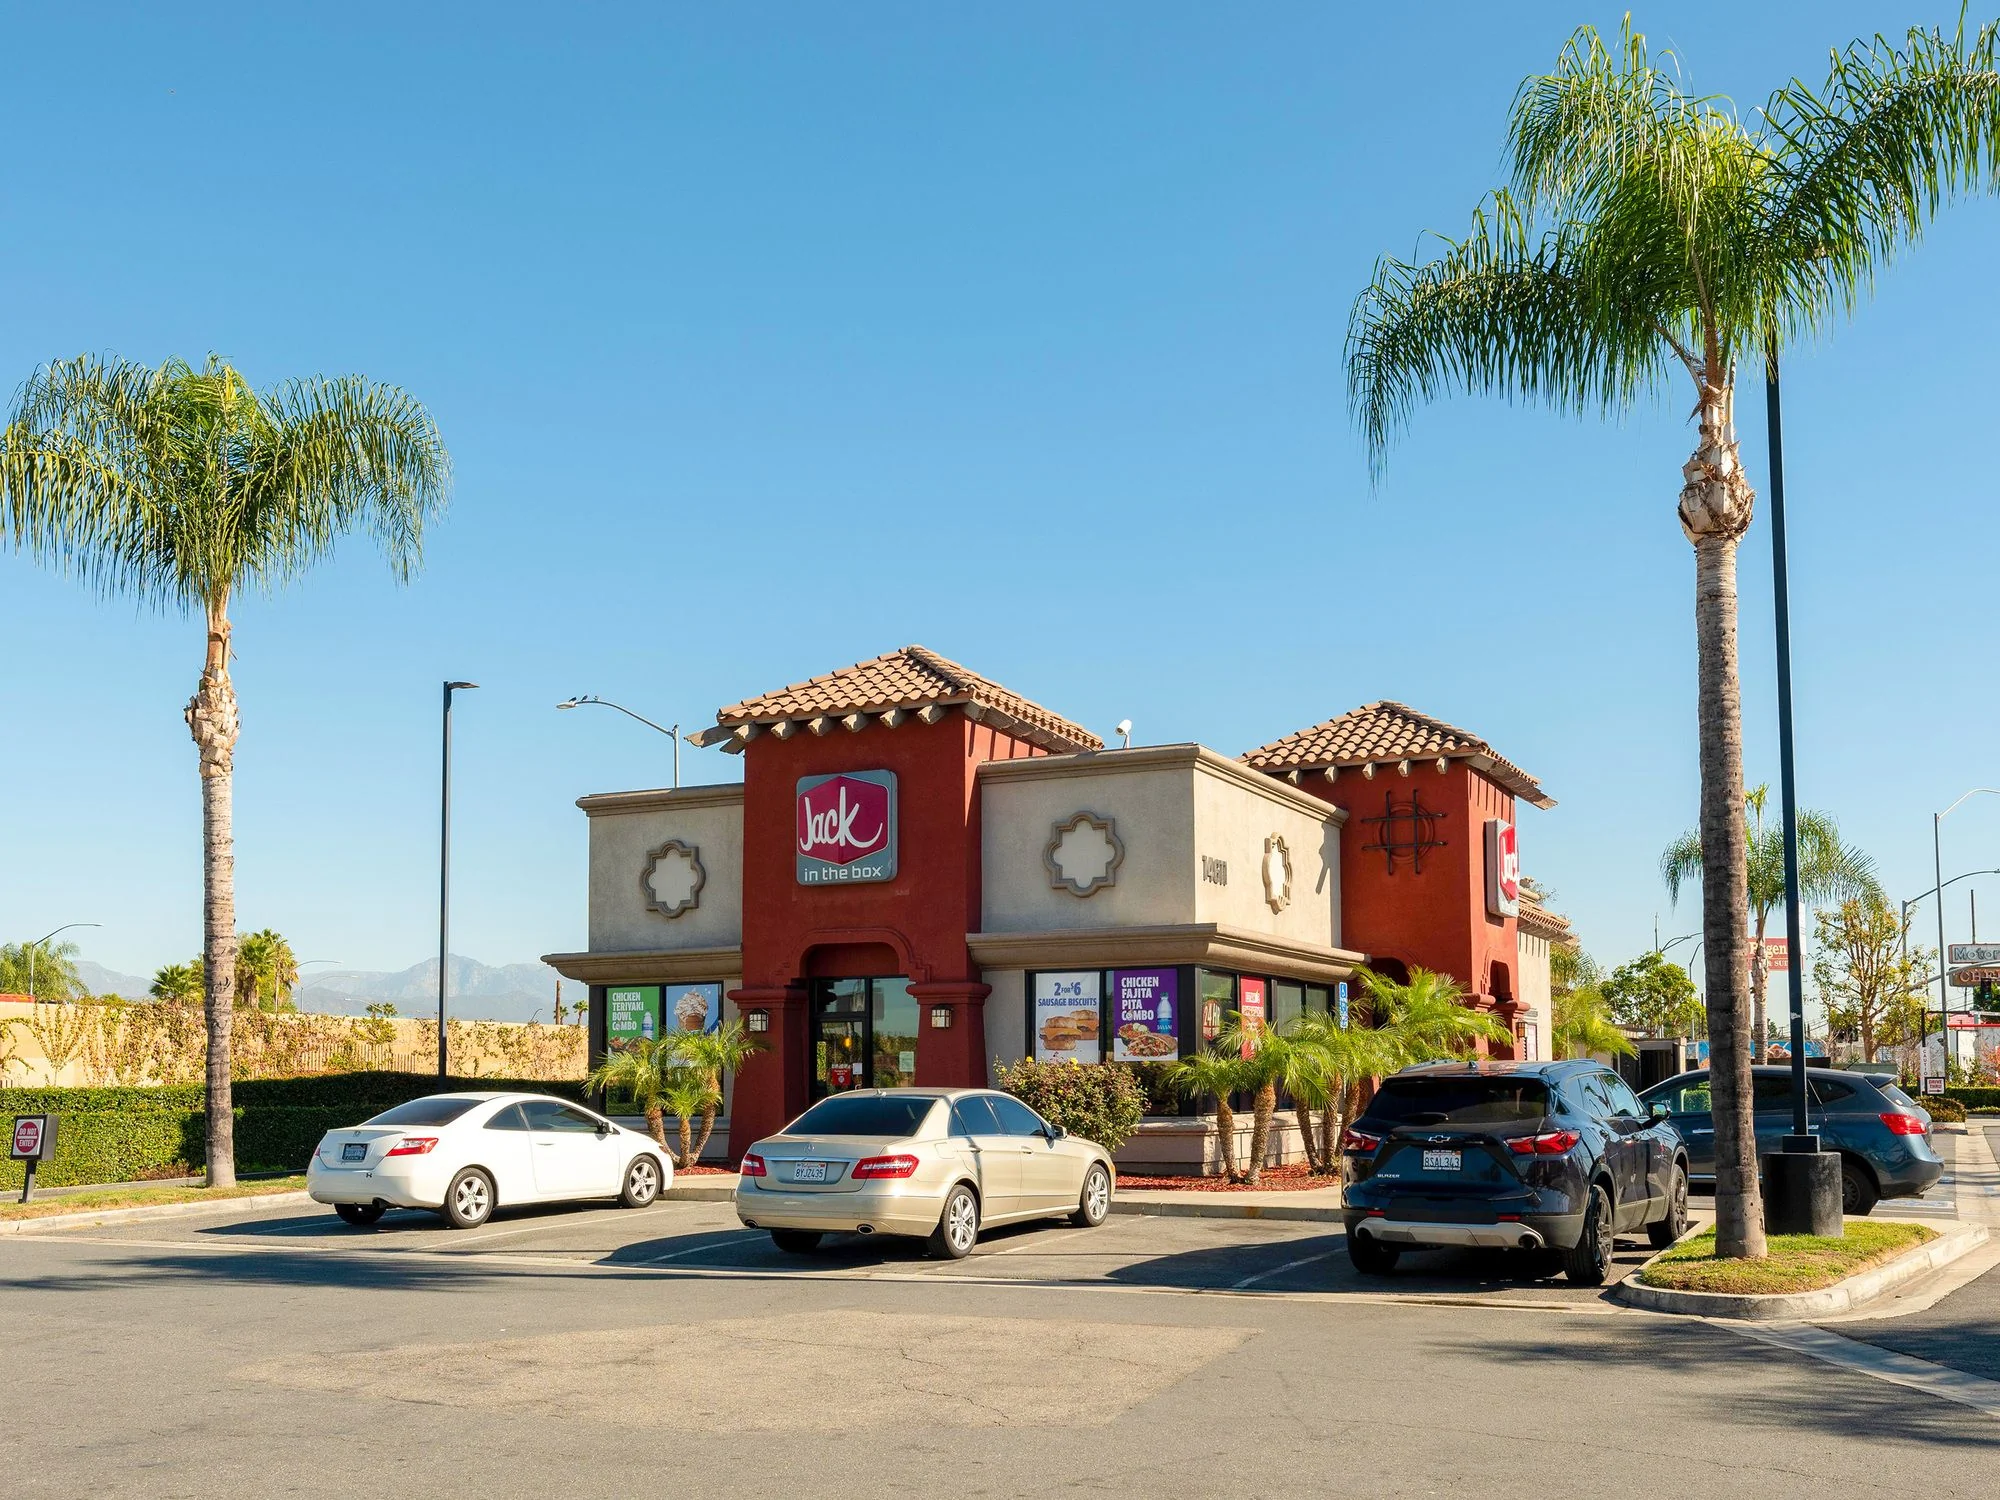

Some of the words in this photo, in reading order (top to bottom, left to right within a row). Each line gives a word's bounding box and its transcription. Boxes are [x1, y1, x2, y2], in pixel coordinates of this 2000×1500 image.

[800, 786, 883, 851] Jack
[804, 868, 818, 881] in
[822, 866, 848, 880] the
[852, 865, 881, 878] box
[1121, 976, 1159, 988] CHICKEN
[1054, 982, 1061, 996] 2
[1122, 988, 1153, 999] FAJITA
[612, 992, 641, 1002] CHICKEN
[1038, 998, 1067, 1007] SAUSAGE
[1068, 997, 1097, 1007] BISCUITS
[612, 1002, 644, 1012] TERIYAKI
[1122, 999, 1143, 1010] PITA
[612, 1011, 632, 1021] BOWL
